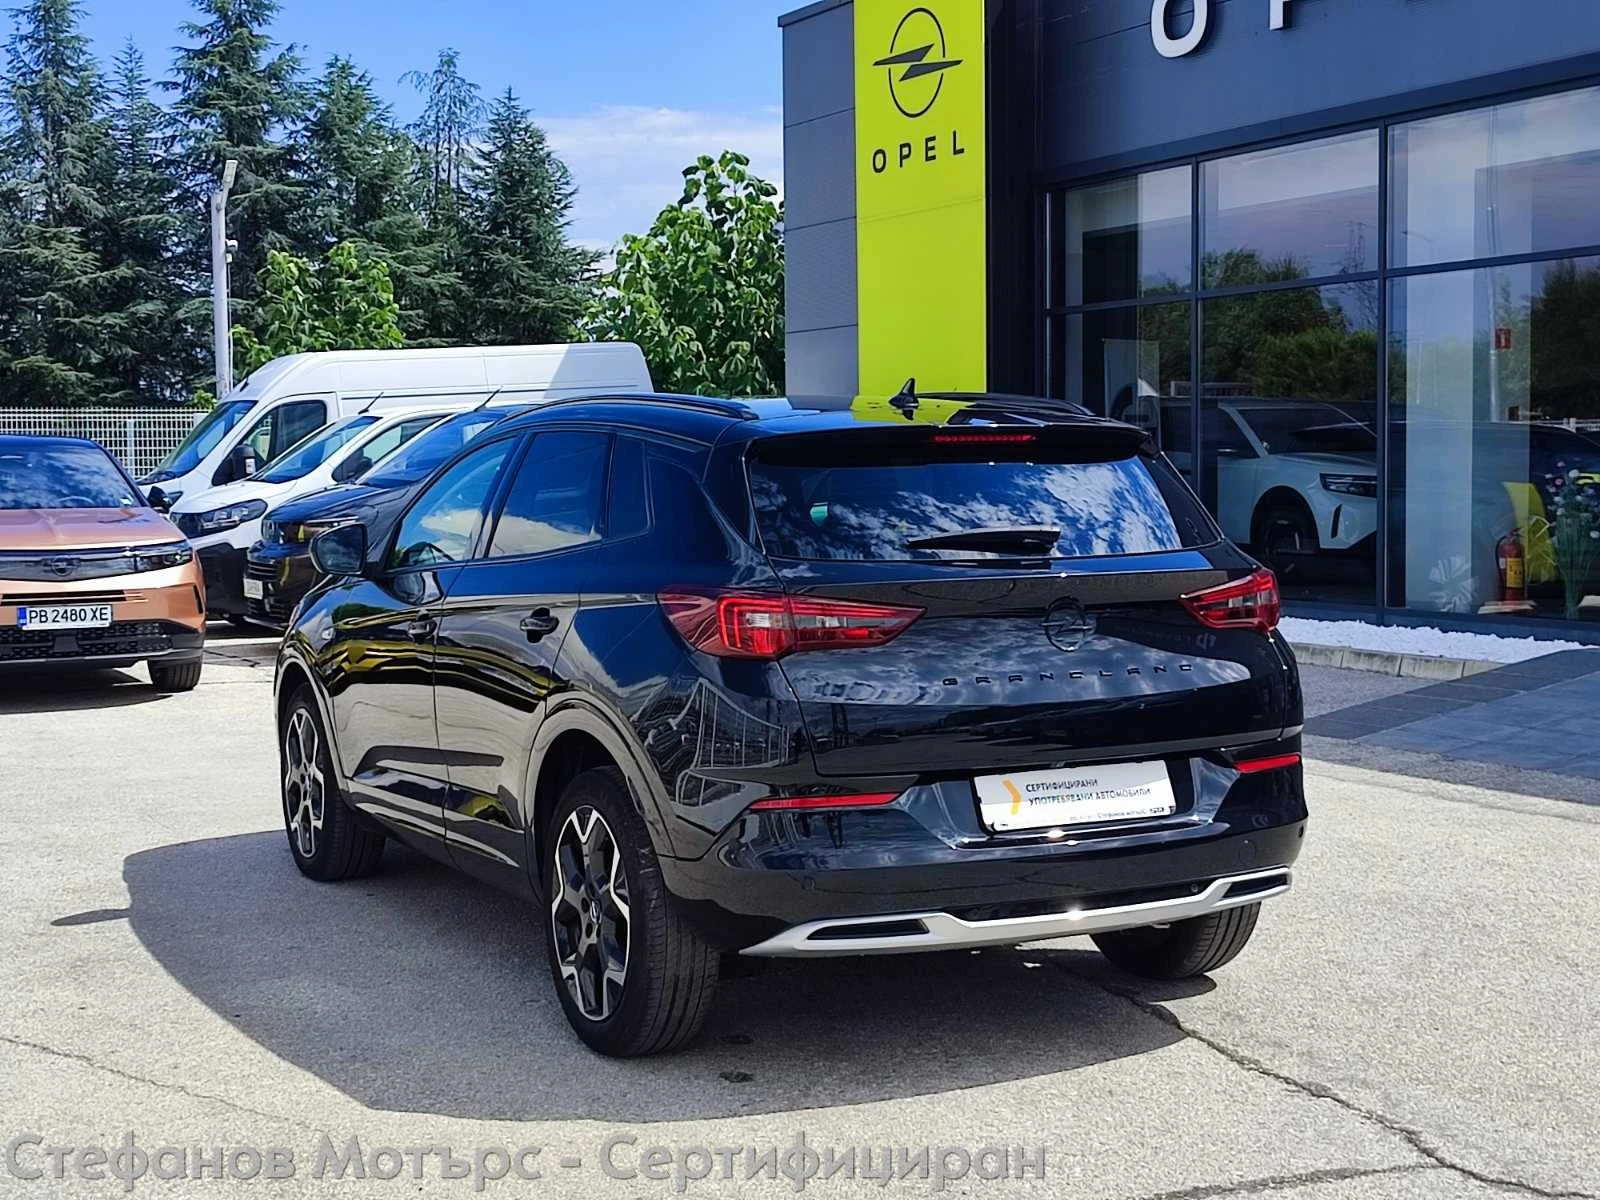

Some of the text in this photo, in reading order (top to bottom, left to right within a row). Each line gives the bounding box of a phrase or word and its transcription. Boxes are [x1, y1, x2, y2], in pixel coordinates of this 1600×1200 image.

[872, 130, 965, 173] OPEL
[28, 607, 109, 624] PB 2480 XE
[942, 663, 1193, 687] GRANDLAND
[1025, 778, 1099, 793] СЕРТИФИЦИРАНИ
[1095, 788, 1152, 801] АВТОМОБИЛИ
